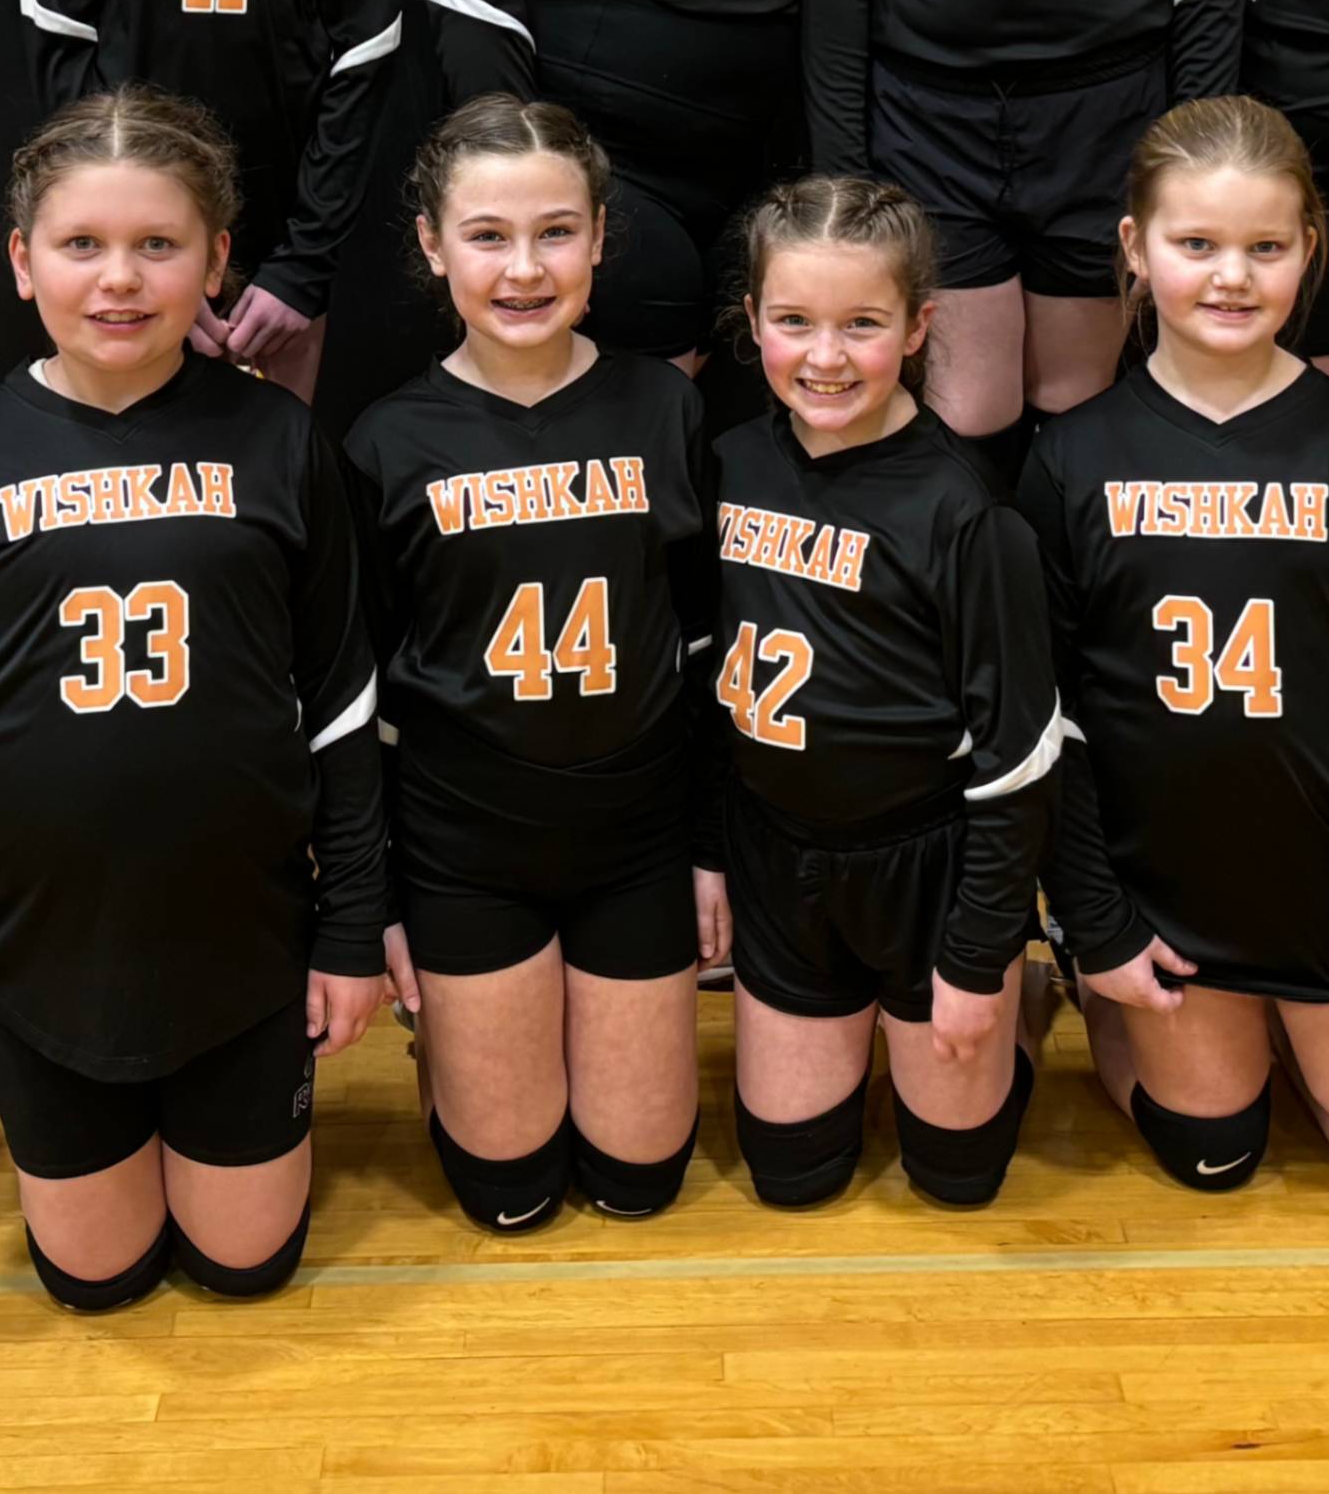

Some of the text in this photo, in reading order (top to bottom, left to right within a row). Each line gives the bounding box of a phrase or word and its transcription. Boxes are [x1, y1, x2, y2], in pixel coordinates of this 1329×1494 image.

[426, 457, 649, 535] WISHKAH
[1104, 481, 1329, 542] WISHKAH
[58, 579, 190, 714] 33
[484, 577, 616, 701] 44
[716, 620, 815, 752] 42
[1152, 594, 1283, 719] 34
